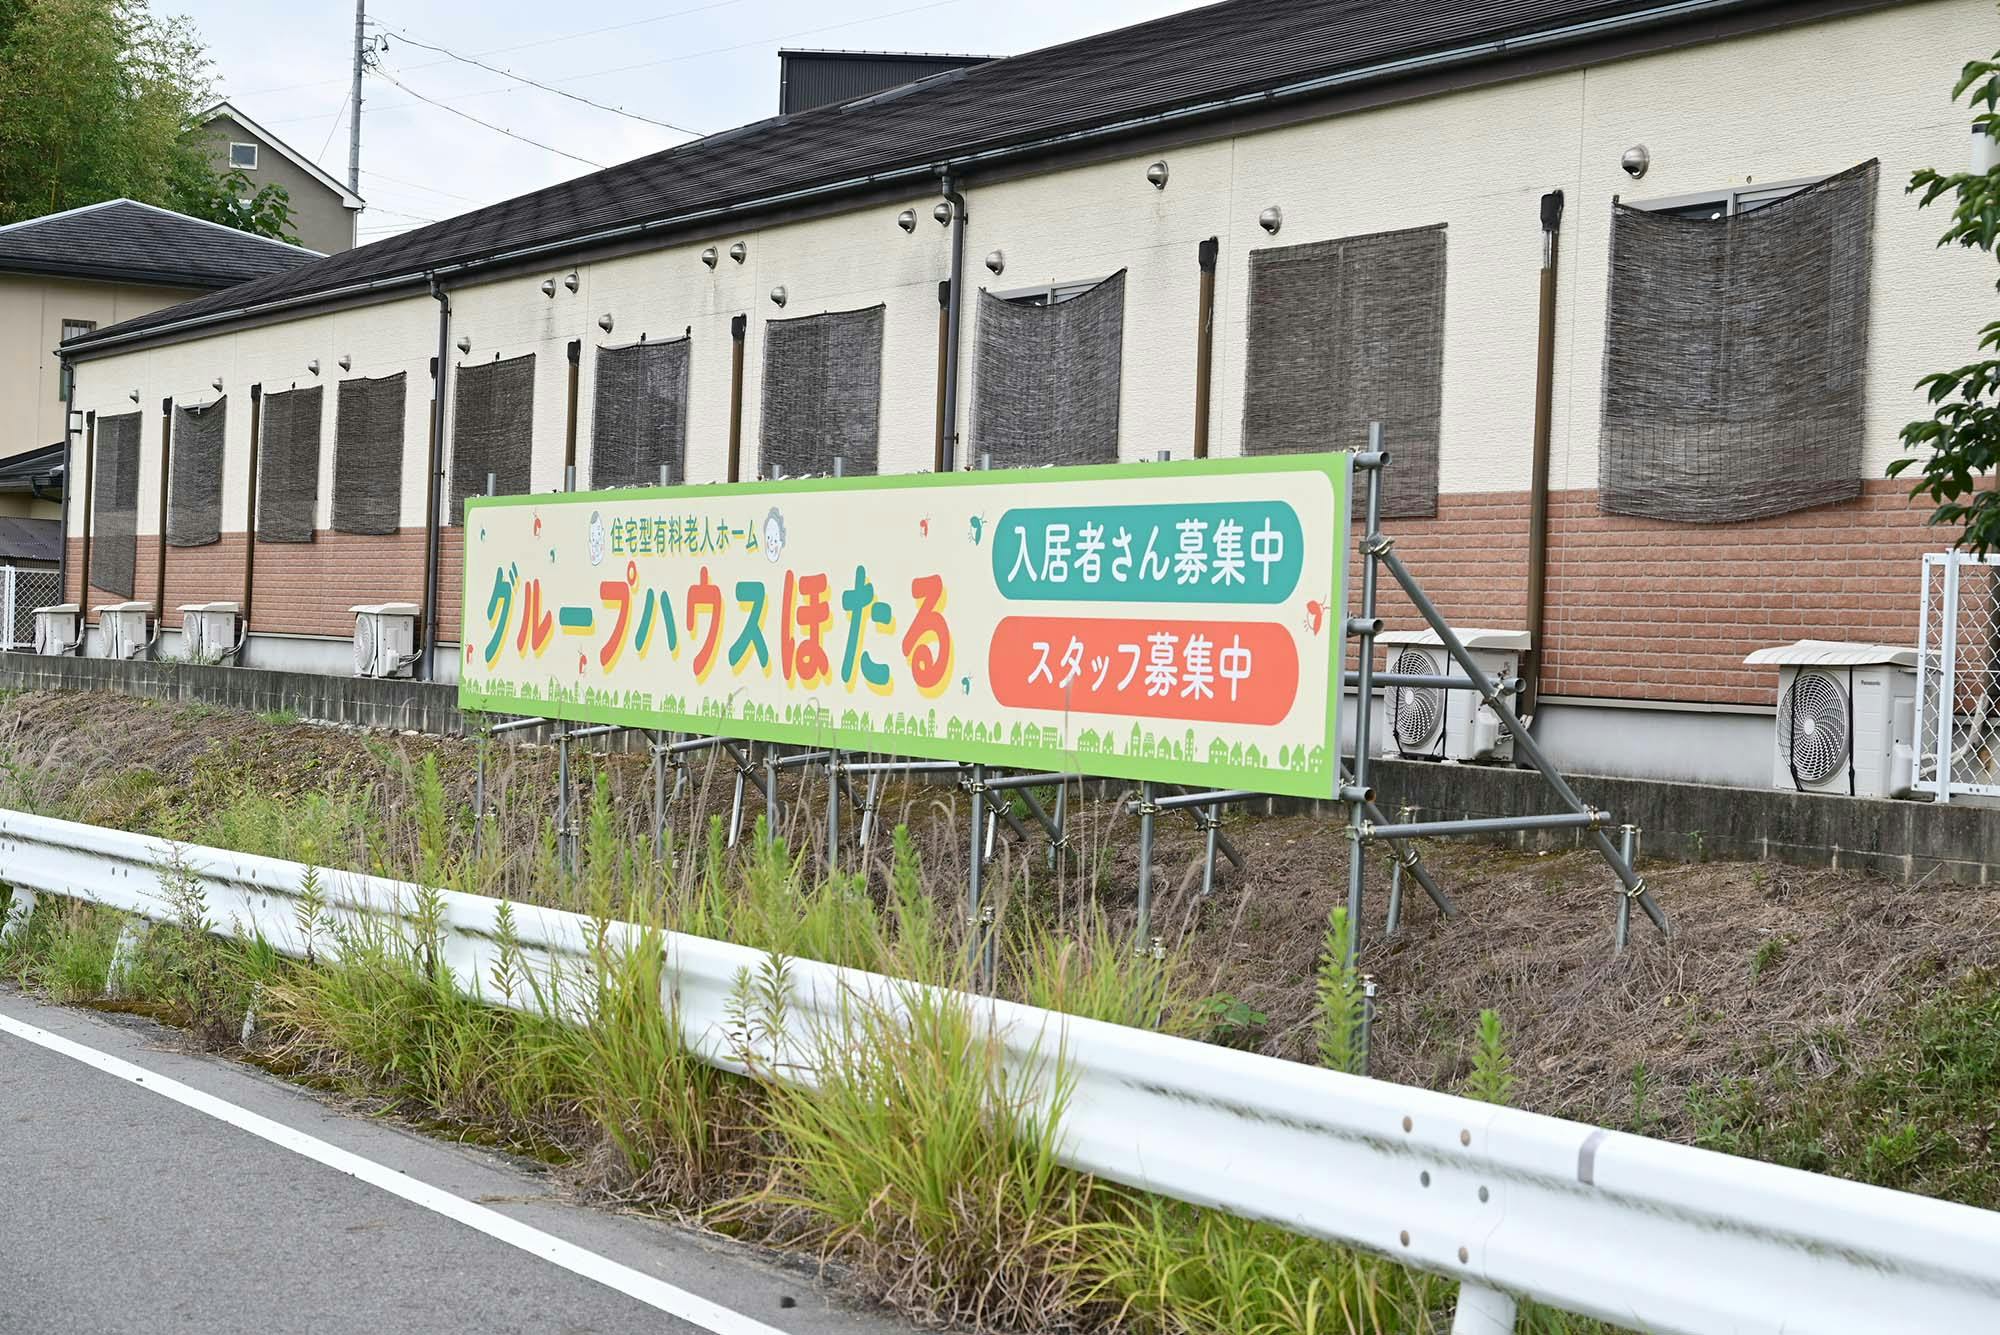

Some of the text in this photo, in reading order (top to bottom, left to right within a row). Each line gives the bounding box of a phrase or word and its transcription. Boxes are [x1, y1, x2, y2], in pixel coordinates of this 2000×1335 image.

[610, 515, 759, 555] 住宅型有料老人ホーム
[1007, 517, 1284, 586] 入居者さん募集中
[485, 561, 955, 694] グループハウスほたる
[1027, 632, 1253, 702] スタッフ募集中
